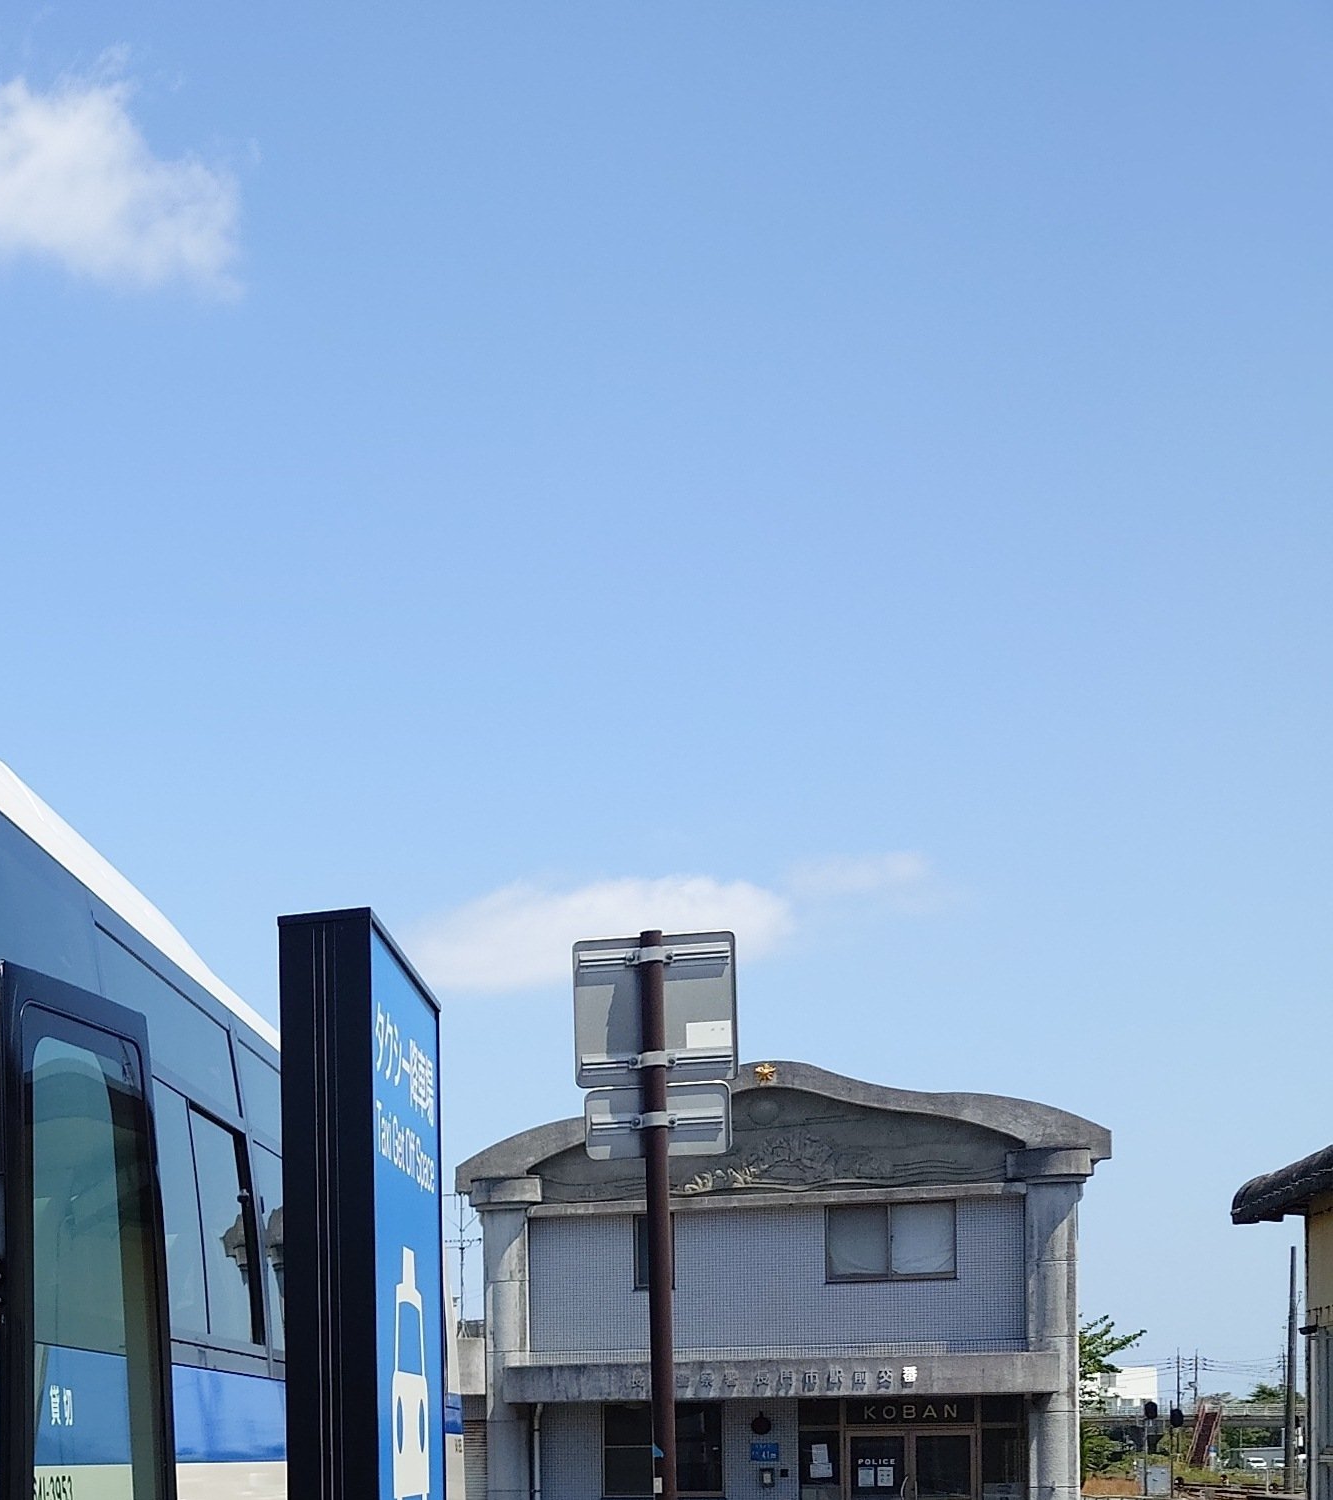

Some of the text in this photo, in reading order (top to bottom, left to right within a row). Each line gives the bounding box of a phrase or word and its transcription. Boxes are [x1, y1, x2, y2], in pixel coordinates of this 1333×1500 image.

[376, 1099, 435, 1194] Taxi Get Off Space
[49, 1384, 74, 1426] 貸切
[863, 1404, 958, 1420] KOBAN
